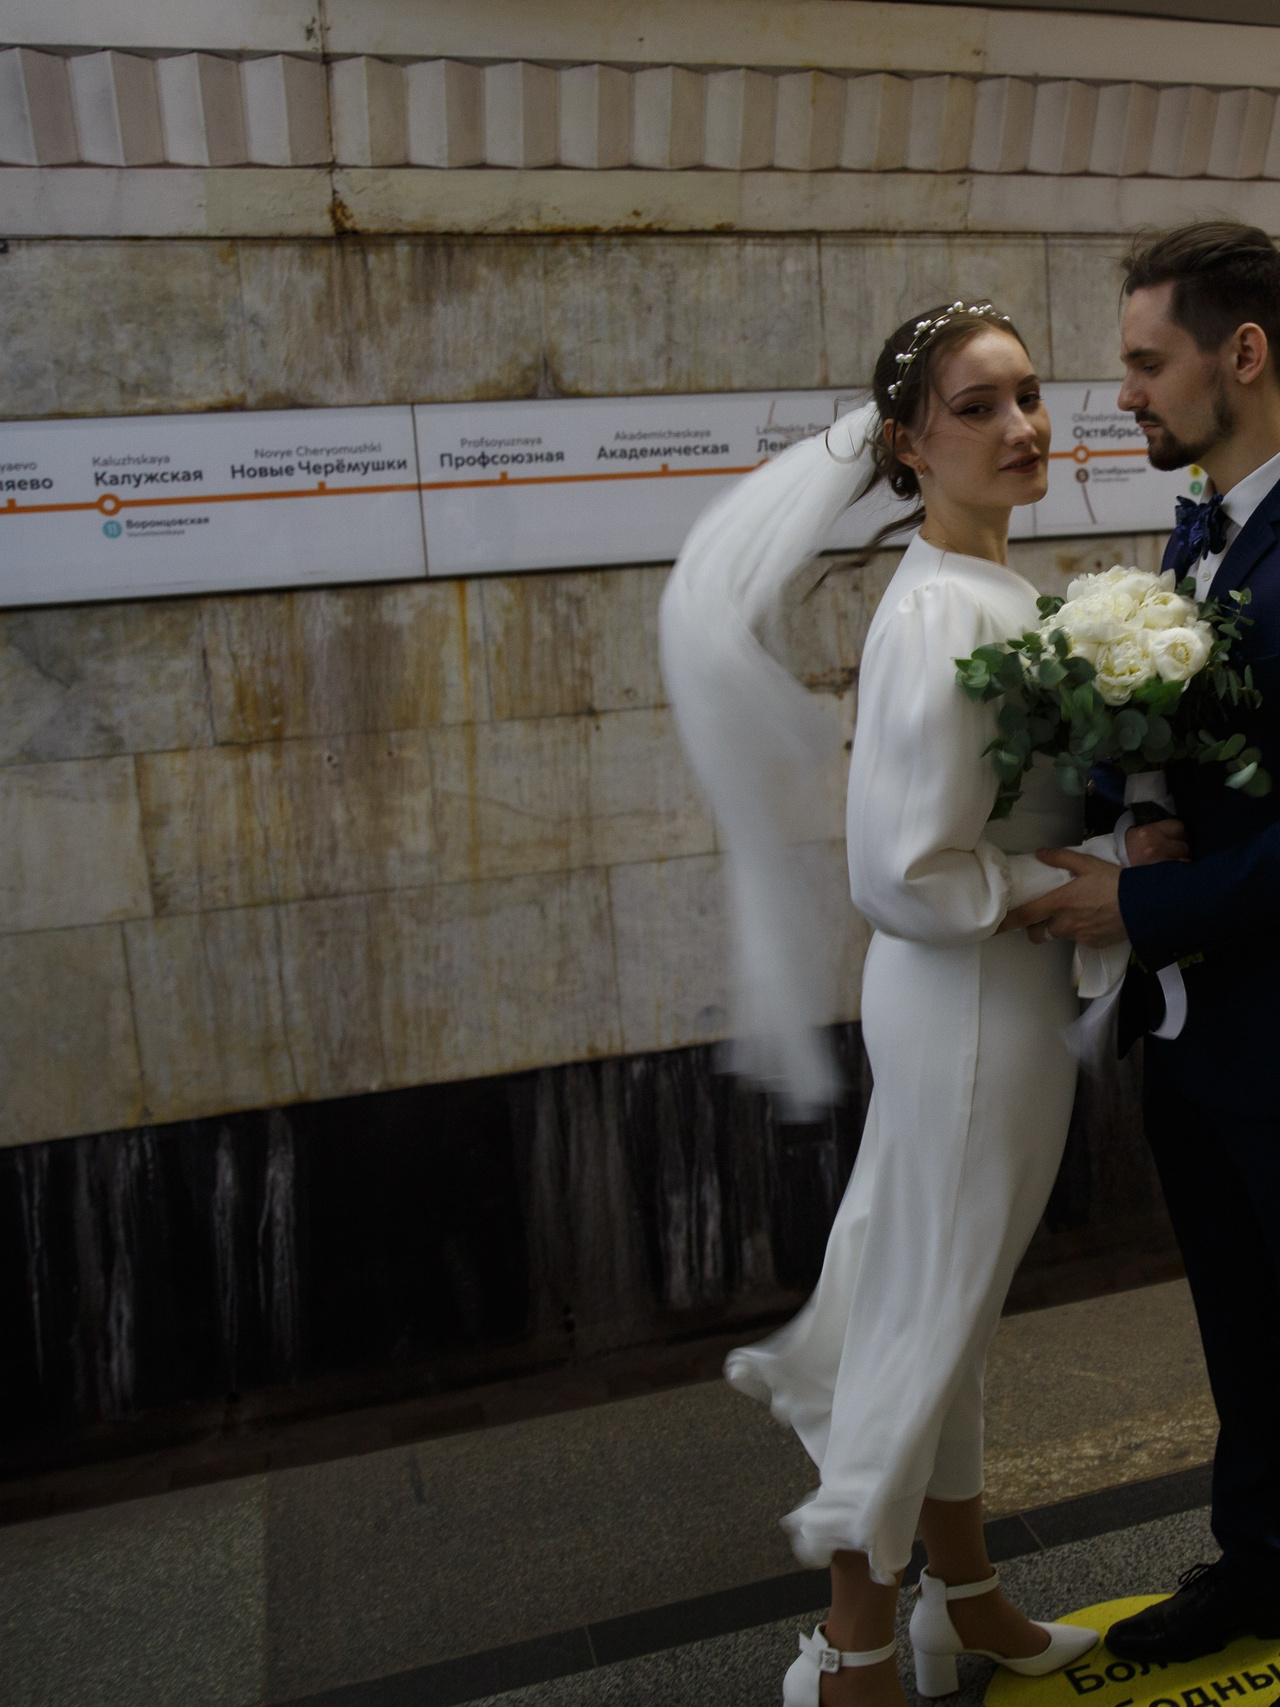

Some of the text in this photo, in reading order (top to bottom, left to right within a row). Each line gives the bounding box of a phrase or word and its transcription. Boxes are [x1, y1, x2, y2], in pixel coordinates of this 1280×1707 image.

[1072, 424, 1145, 439] Октябрьс
[460, 436, 543, 449] Profsoyuznaya
[92, 453, 170, 467] Kaluzhskaya
[254, 443, 382, 460] Novye Cheryomushki
[439, 450, 565, 470] Профсоюзная
[597, 443, 730, 461] Академическая
[230, 458, 408, 479] Новые Черёмушки
[94, 469, 204, 489] Калужская
[126, 516, 210, 529] Воронцовская
